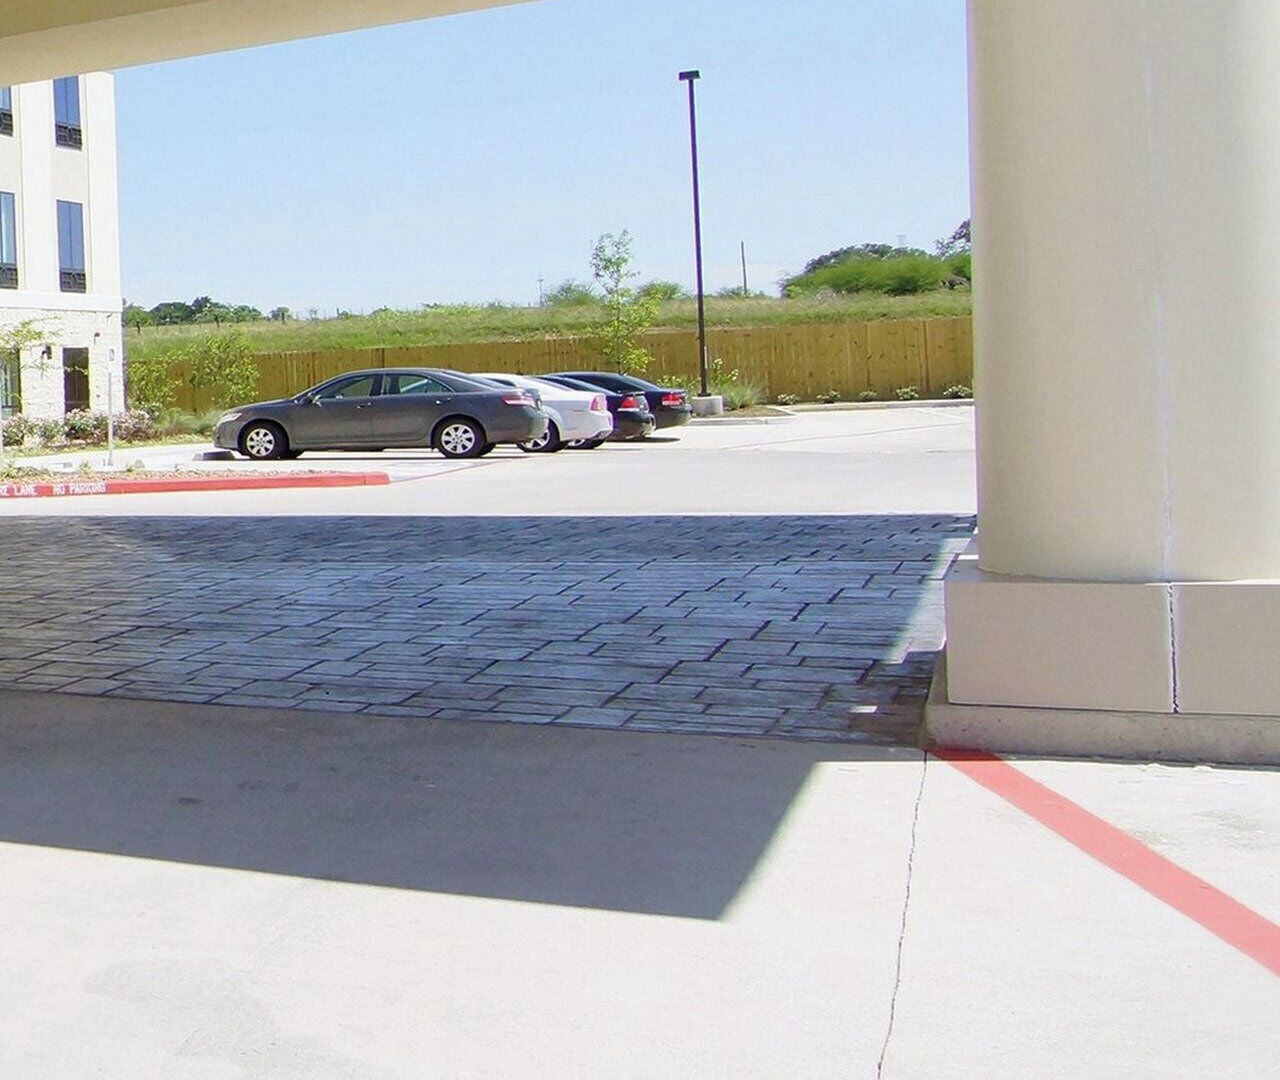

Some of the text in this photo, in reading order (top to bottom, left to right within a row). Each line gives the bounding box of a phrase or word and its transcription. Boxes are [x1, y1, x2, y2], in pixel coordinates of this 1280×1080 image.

[13, 483, 38, 496] LANE
[52, 483, 66, 495] NO
[69, 481, 107, 494] PARKING
